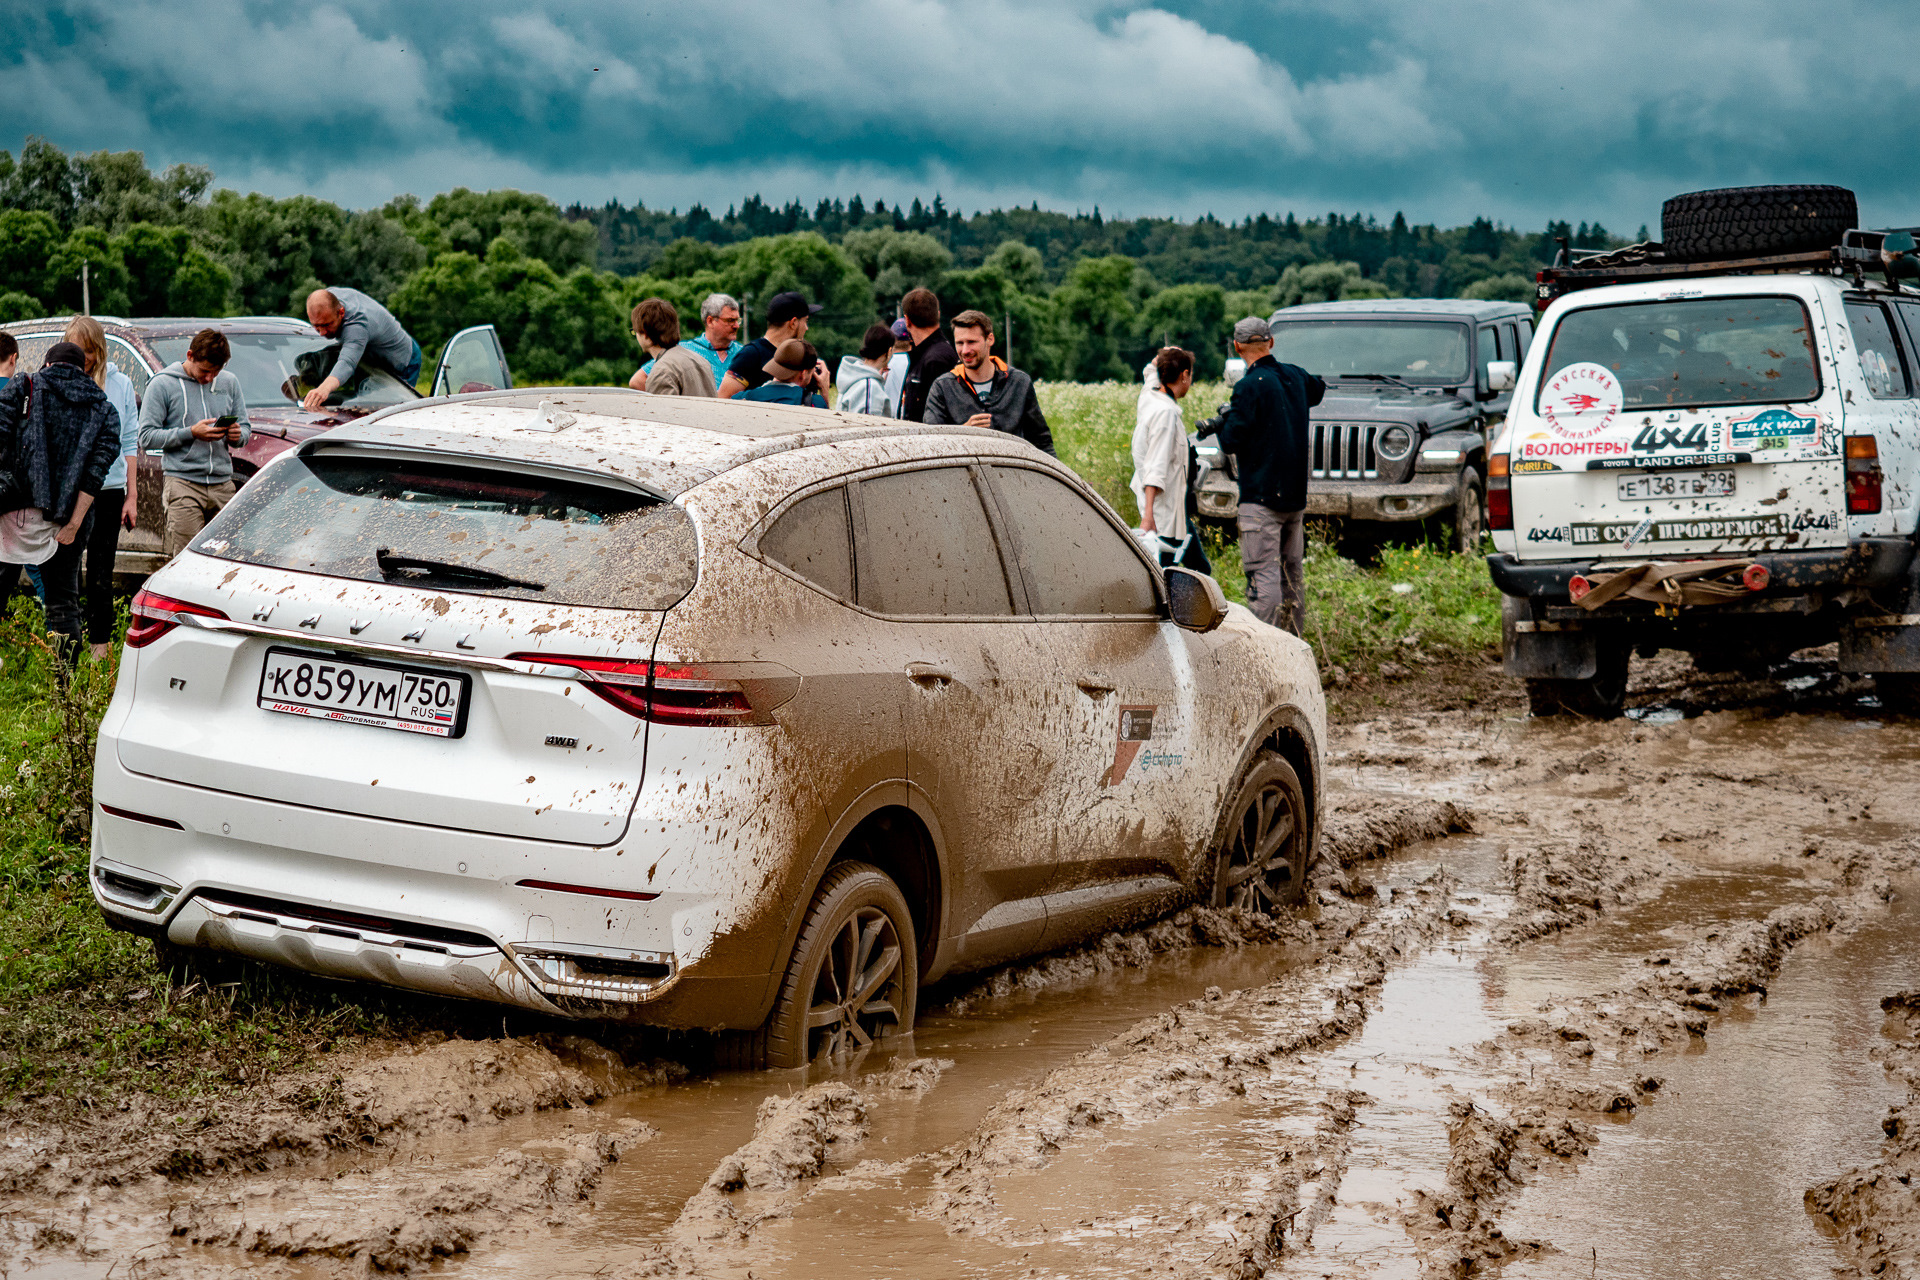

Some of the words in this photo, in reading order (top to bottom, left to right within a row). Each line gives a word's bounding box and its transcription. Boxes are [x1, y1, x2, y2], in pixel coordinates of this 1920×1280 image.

[1544, 403, 1617, 439] МОТОЦИКЛИСТЫ
[1735, 421, 1774, 433] SILK
[1776, 420, 1812, 430] WAY
[1710, 422, 1721, 452] CLUB
[1525, 442, 1628, 456] ВОЛОНТЕРЫ
[1514, 461, 1553, 472] 4x4RU.ru
[1634, 457, 1671, 467] LAND
[1674, 454, 1736, 466] CRUISER
[1572, 526, 1599, 542] НЕ
[252, 604, 476, 650] HAVAL
[169, 677, 187, 691] F7
[272, 663, 397, 711] К859УМ
[403, 675, 451, 707] 750
[272, 703, 311, 715] HAVAL
[411, 706, 435, 719] RUS
[323, 712, 387, 726] АВТОПРЕМЬЕР
[396, 720, 413, 730] (495)
[546, 735, 576, 747] 4WD
